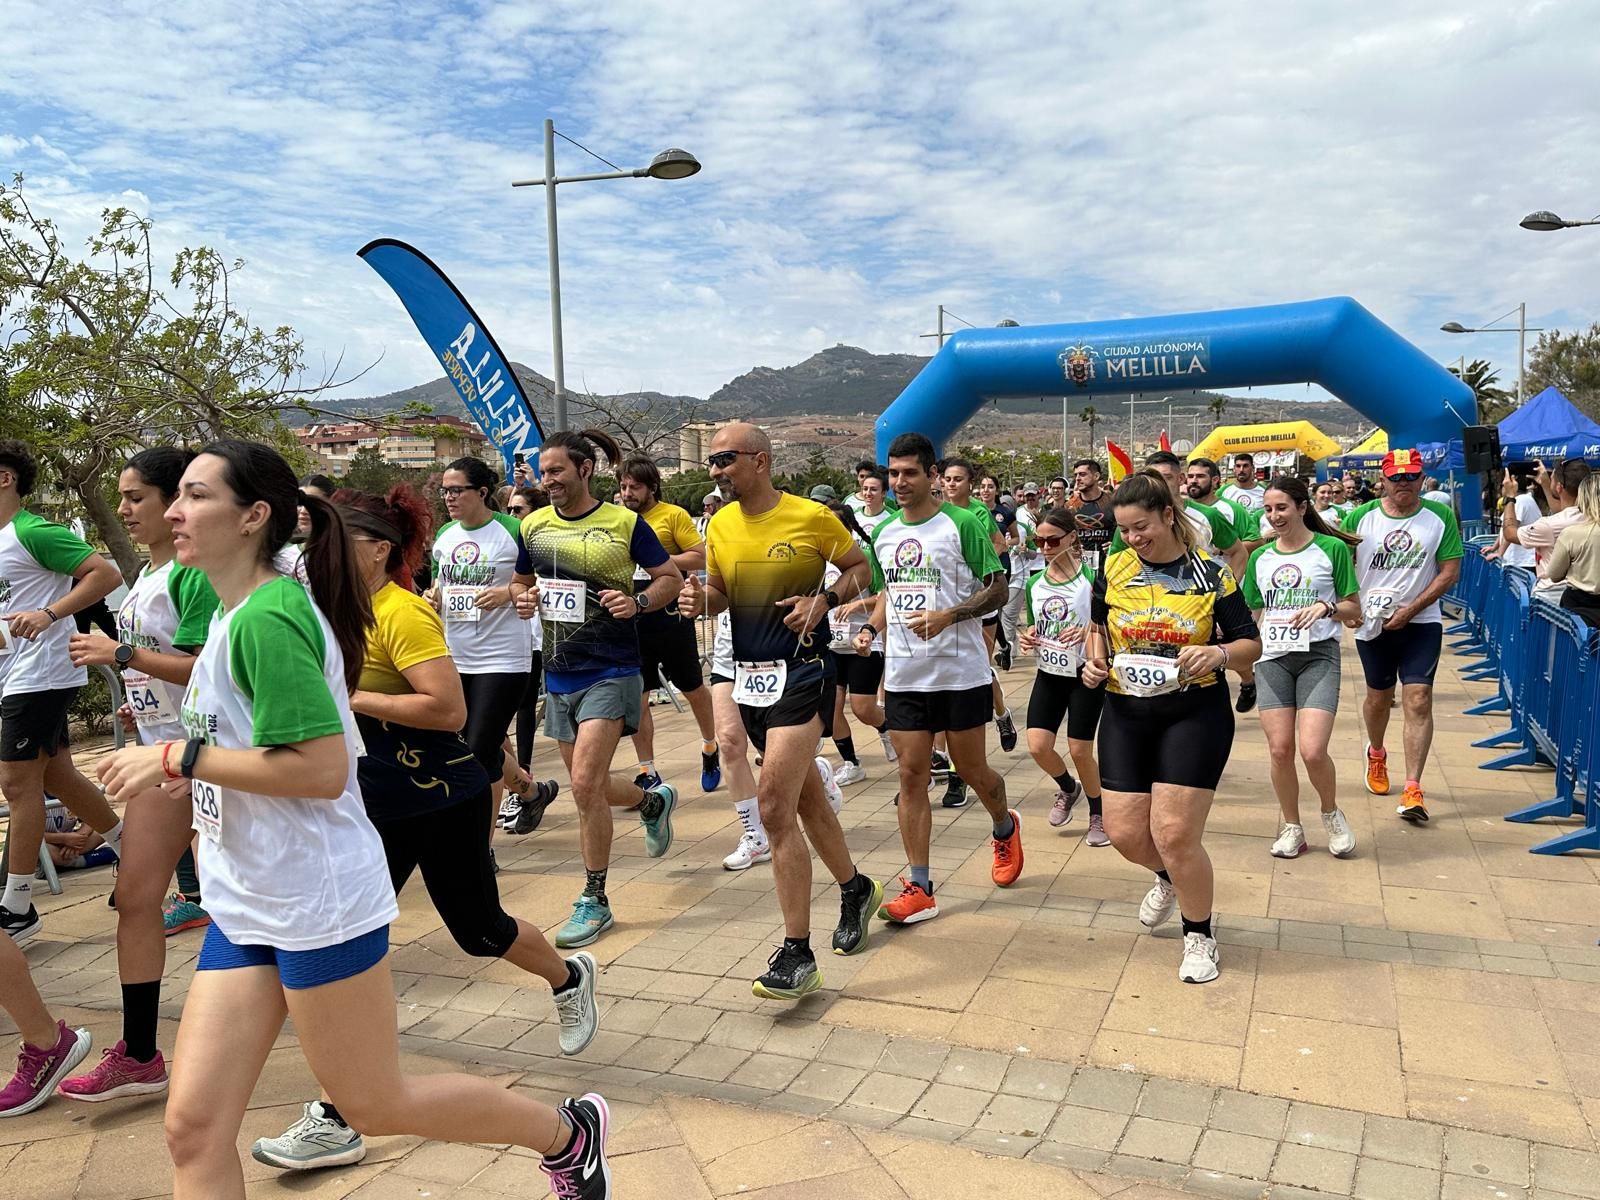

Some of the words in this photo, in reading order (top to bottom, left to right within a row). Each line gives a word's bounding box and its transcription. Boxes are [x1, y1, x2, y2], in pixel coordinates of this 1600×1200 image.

[1103, 345, 1140, 356] CIUDAD
[1142, 341, 1205, 354] AUTÓNOMA
[1105, 354, 1207, 378] MELILLA
[1241, 435, 1270, 444] ATLÉTICO
[1270, 432, 1296, 442] MELILLA
[1524, 445, 1567, 457] MELILLA
[449, 595, 475, 612] 380
[541, 590, 576, 610] 476
[894, 593, 926, 611] 422
[1268, 626, 1300, 641] 379
[1042, 649, 1068, 667] 366
[744, 674, 778, 693] 462
[1125, 666, 1166, 687] 339
[131, 689, 160, 711] 54
[208, 714, 217, 733] 2024
[193, 780, 219, 820] 428
